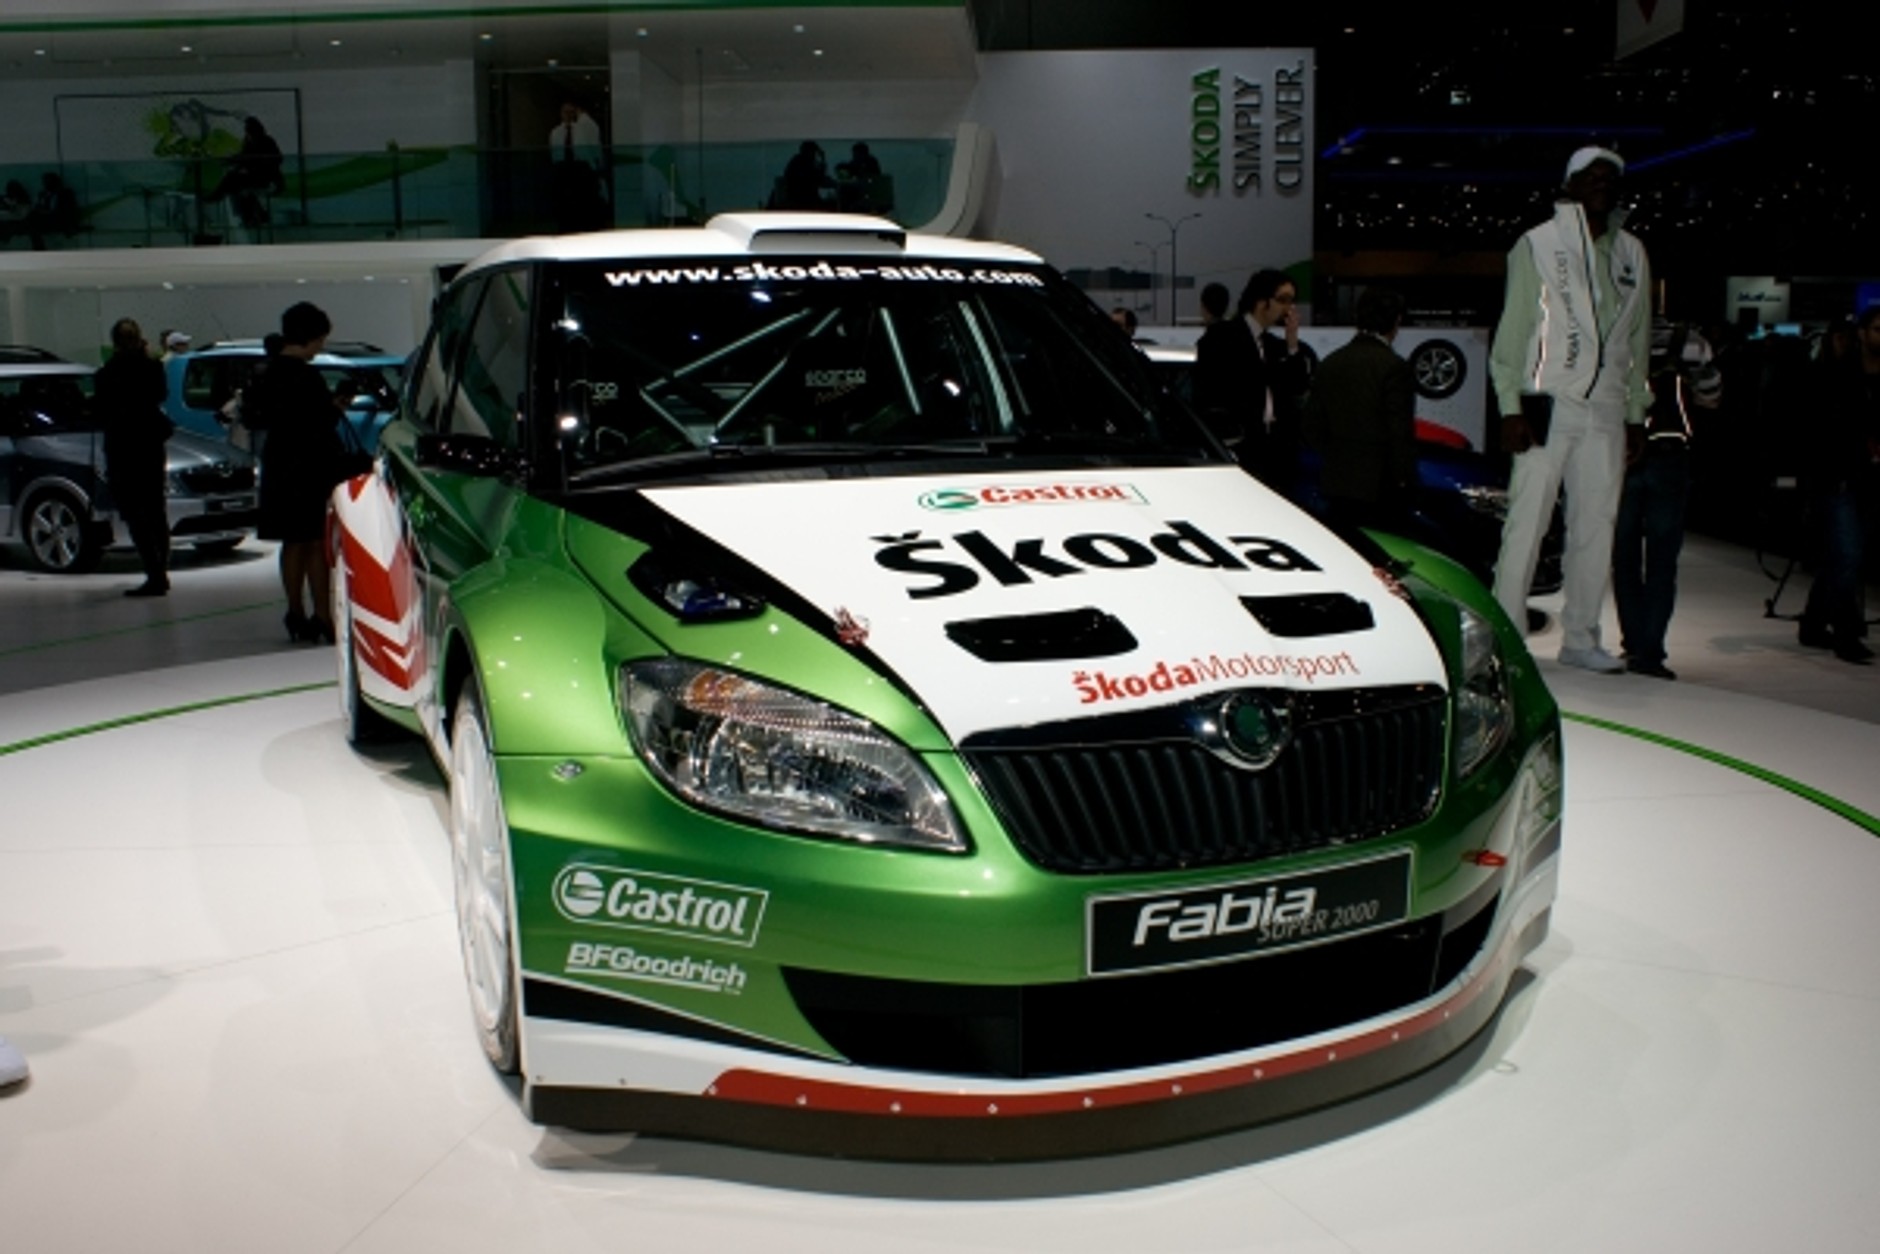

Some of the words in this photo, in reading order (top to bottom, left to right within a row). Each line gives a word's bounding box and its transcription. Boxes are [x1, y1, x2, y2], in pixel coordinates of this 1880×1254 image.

[1188, 67, 1220, 190] ŠKODA
[1234, 76, 1261, 191] SIMPLY
[605, 262, 1044, 287] www.skoda-auto.com
[981, 484, 1131, 503] Castrol
[870, 521, 1323, 600] Škoda
[606, 877, 749, 935] Castrol
[1132, 886, 1317, 946] Fabia
[1257, 908, 1331, 944] SUPER
[1333, 900, 1380, 931] 2000
[567, 942, 747, 989] BFGoodrich
